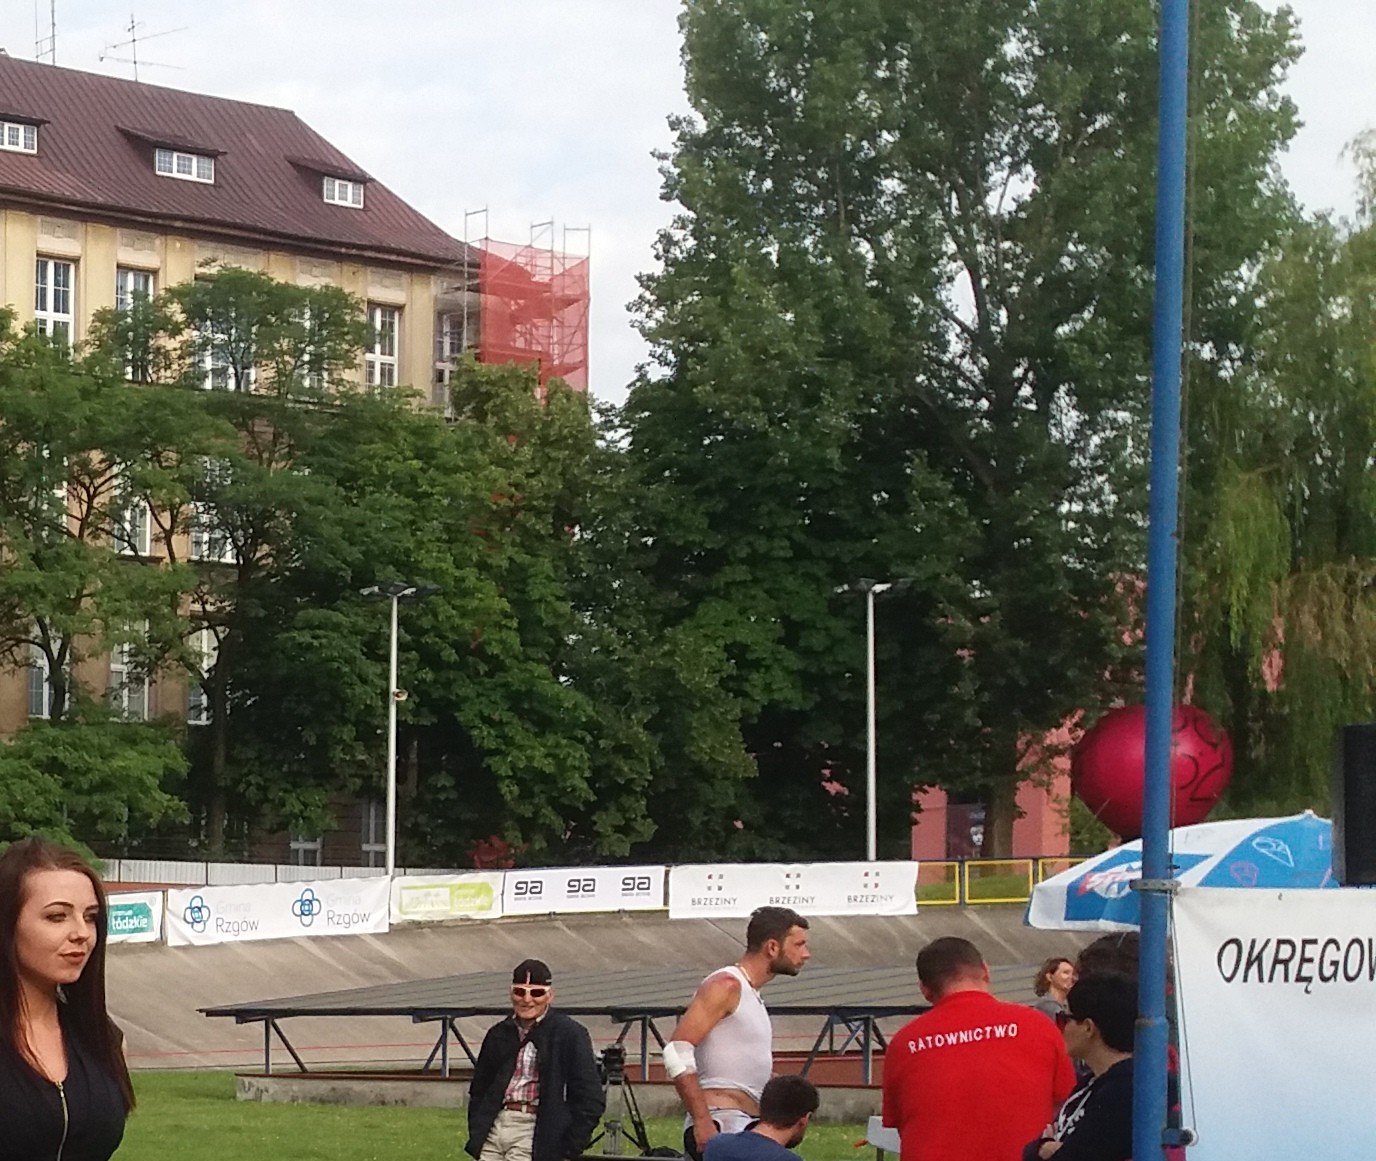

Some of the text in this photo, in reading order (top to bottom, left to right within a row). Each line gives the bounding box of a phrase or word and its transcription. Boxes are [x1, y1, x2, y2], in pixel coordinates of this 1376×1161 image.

[690, 897, 738, 906] BRZEZINY
[768, 896, 816, 905] BRZEZINY
[846, 894, 894, 903] BRZEZINY
[326, 909, 371, 928] Rzgów
[215, 917, 260, 936] Rzgów
[908, 1022, 1019, 1054] RATOWNICTWO
